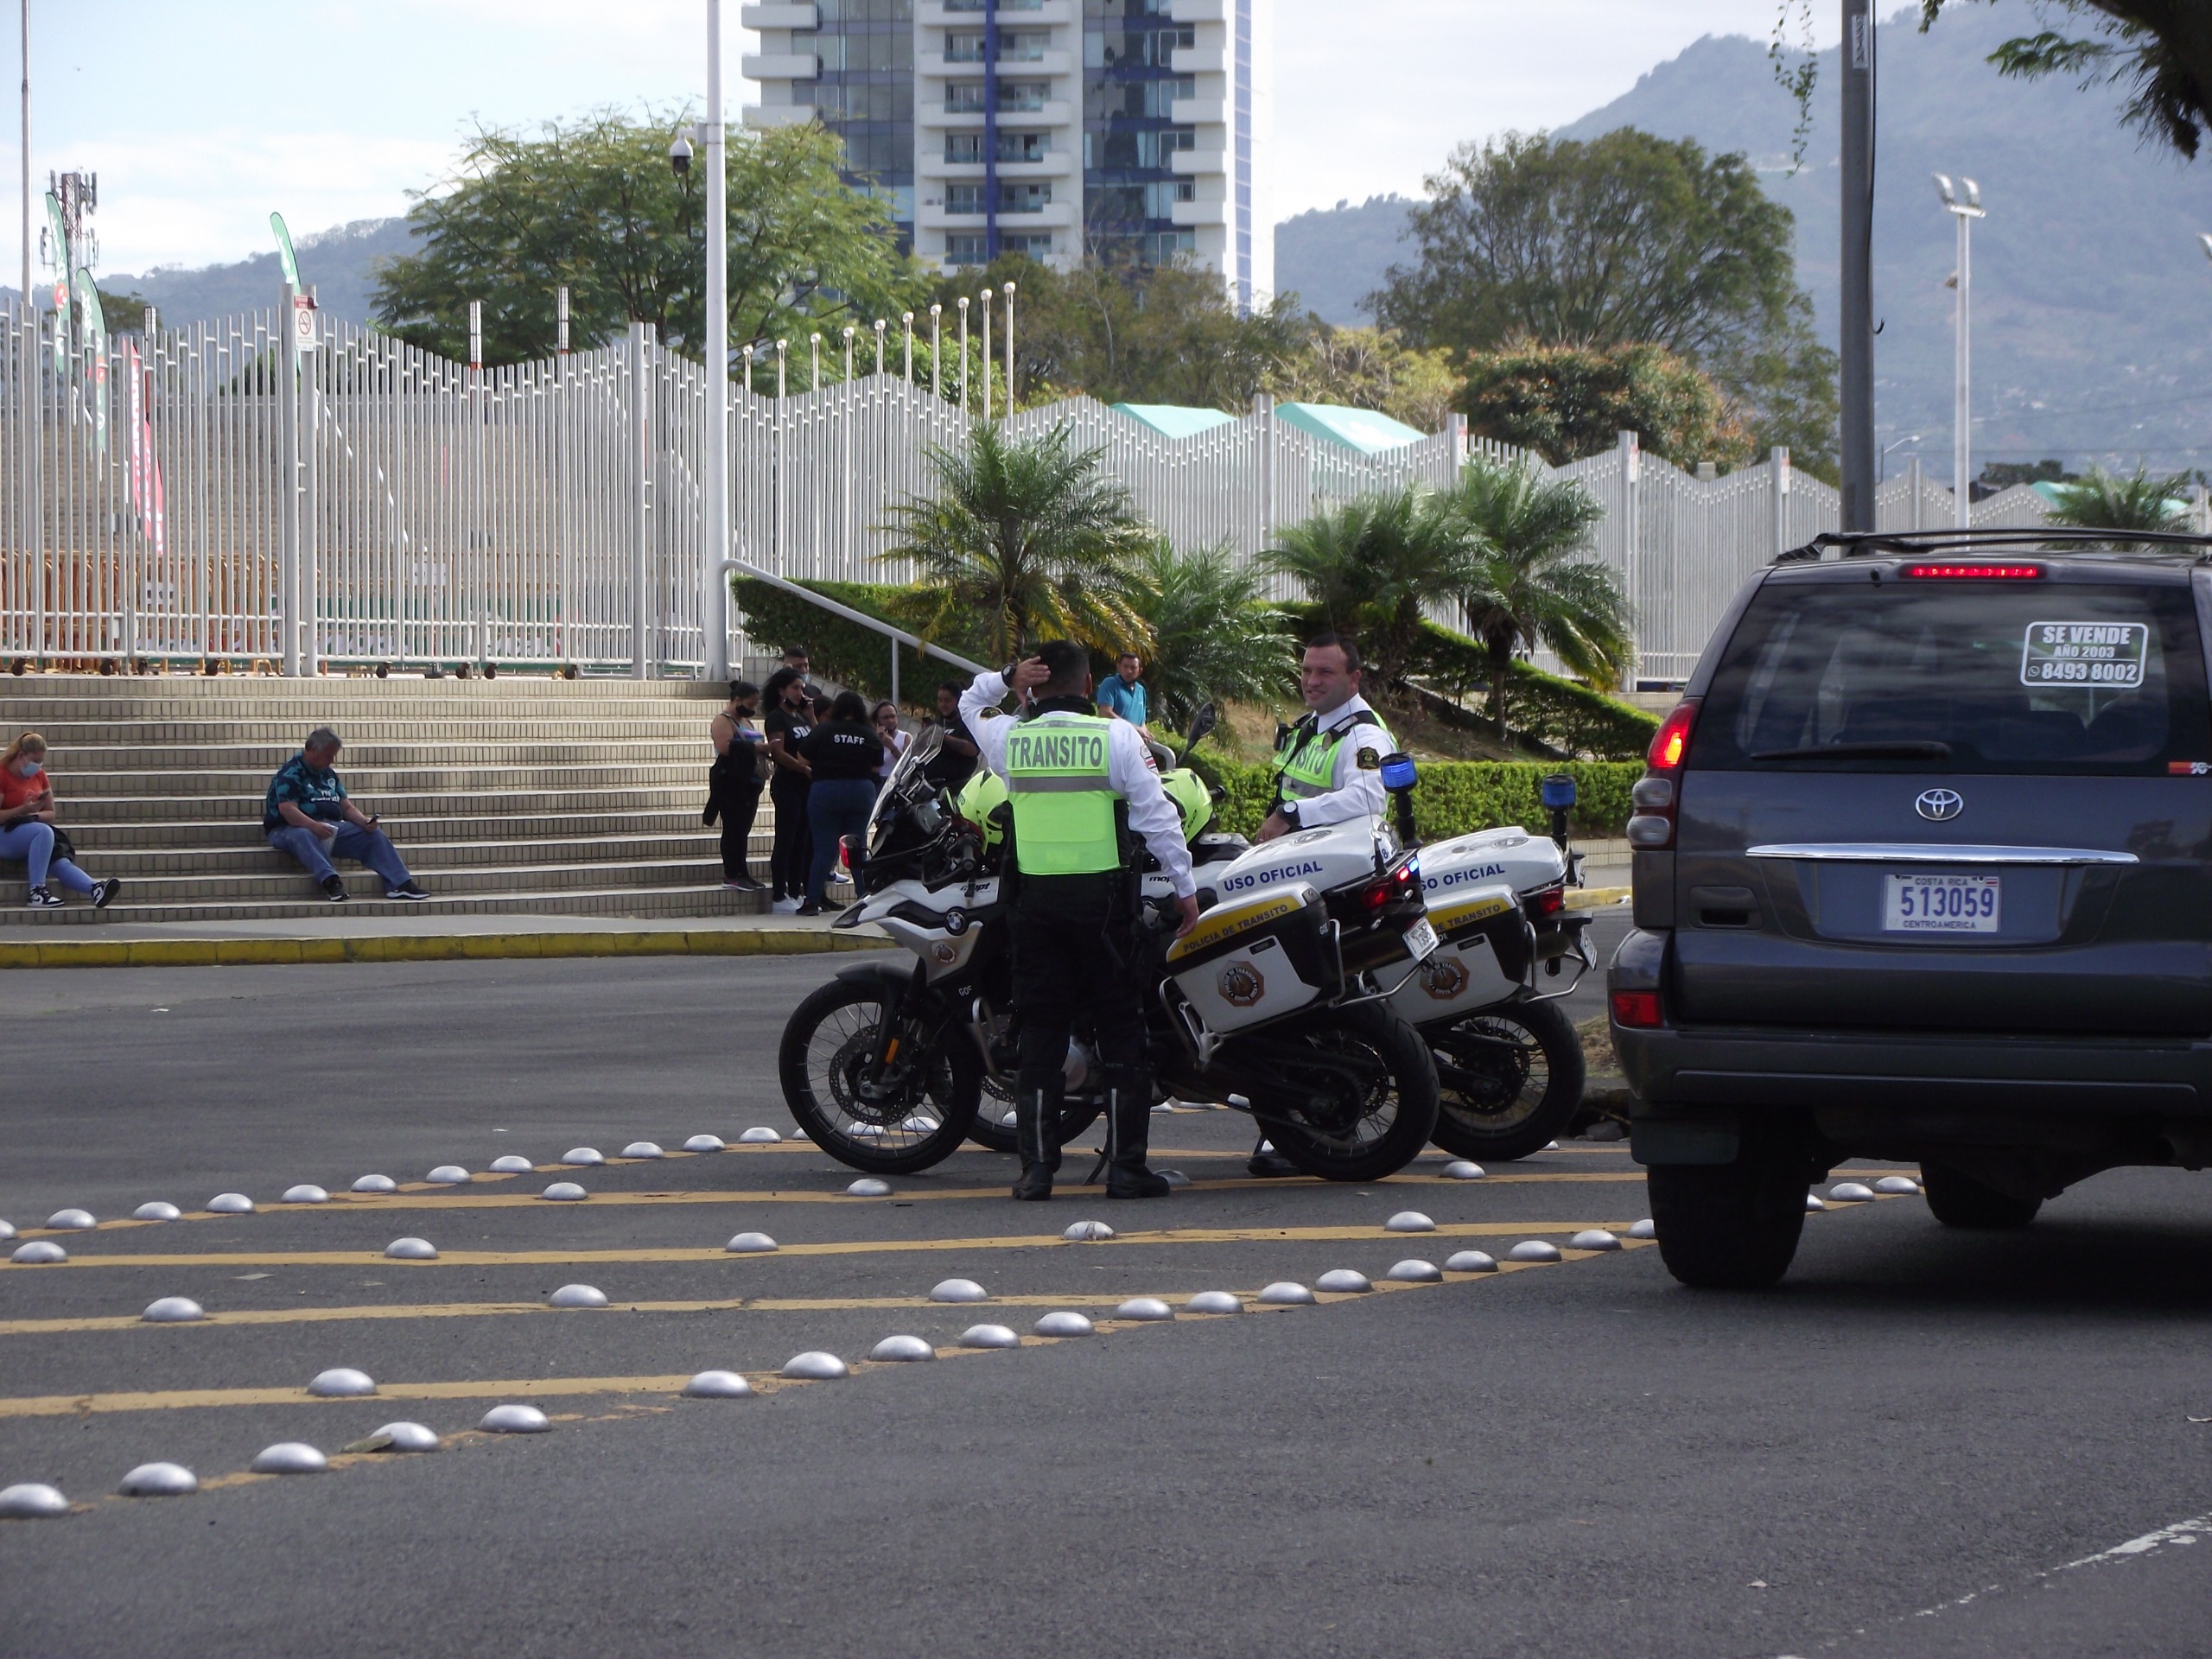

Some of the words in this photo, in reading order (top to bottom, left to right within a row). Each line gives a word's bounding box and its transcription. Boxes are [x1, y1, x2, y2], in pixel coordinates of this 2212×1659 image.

[2043, 626, 2067, 644] SE
[2070, 626, 2131, 645] VENDE
[2054, 645, 2079, 657] AÑO
[2082, 646, 2114, 658] 2003
[2042, 663, 2088, 680] 8493
[2091, 664, 2137, 681] 8002
[834, 734, 865, 745] STAFF
[1010, 736, 1103, 768] TRANSITO
[1224, 875, 1255, 892] USO
[1260, 861, 1323, 883] OFICIAL
[1421, 878, 1438, 891] SO
[1443, 863, 1506, 885] OFICIAL
[1915, 877, 1944, 887] COSTA
[1948, 878, 1968, 887] RICA
[1901, 887, 1994, 918] 513059
[1447, 904, 1501, 927] TRANSITO
[1903, 920, 1976, 930] CENTROAMERICA
[1183, 933, 1221, 952] POLICIA
[1222, 926, 1236, 936] DE
[1237, 905, 1288, 930] TRANSITO
